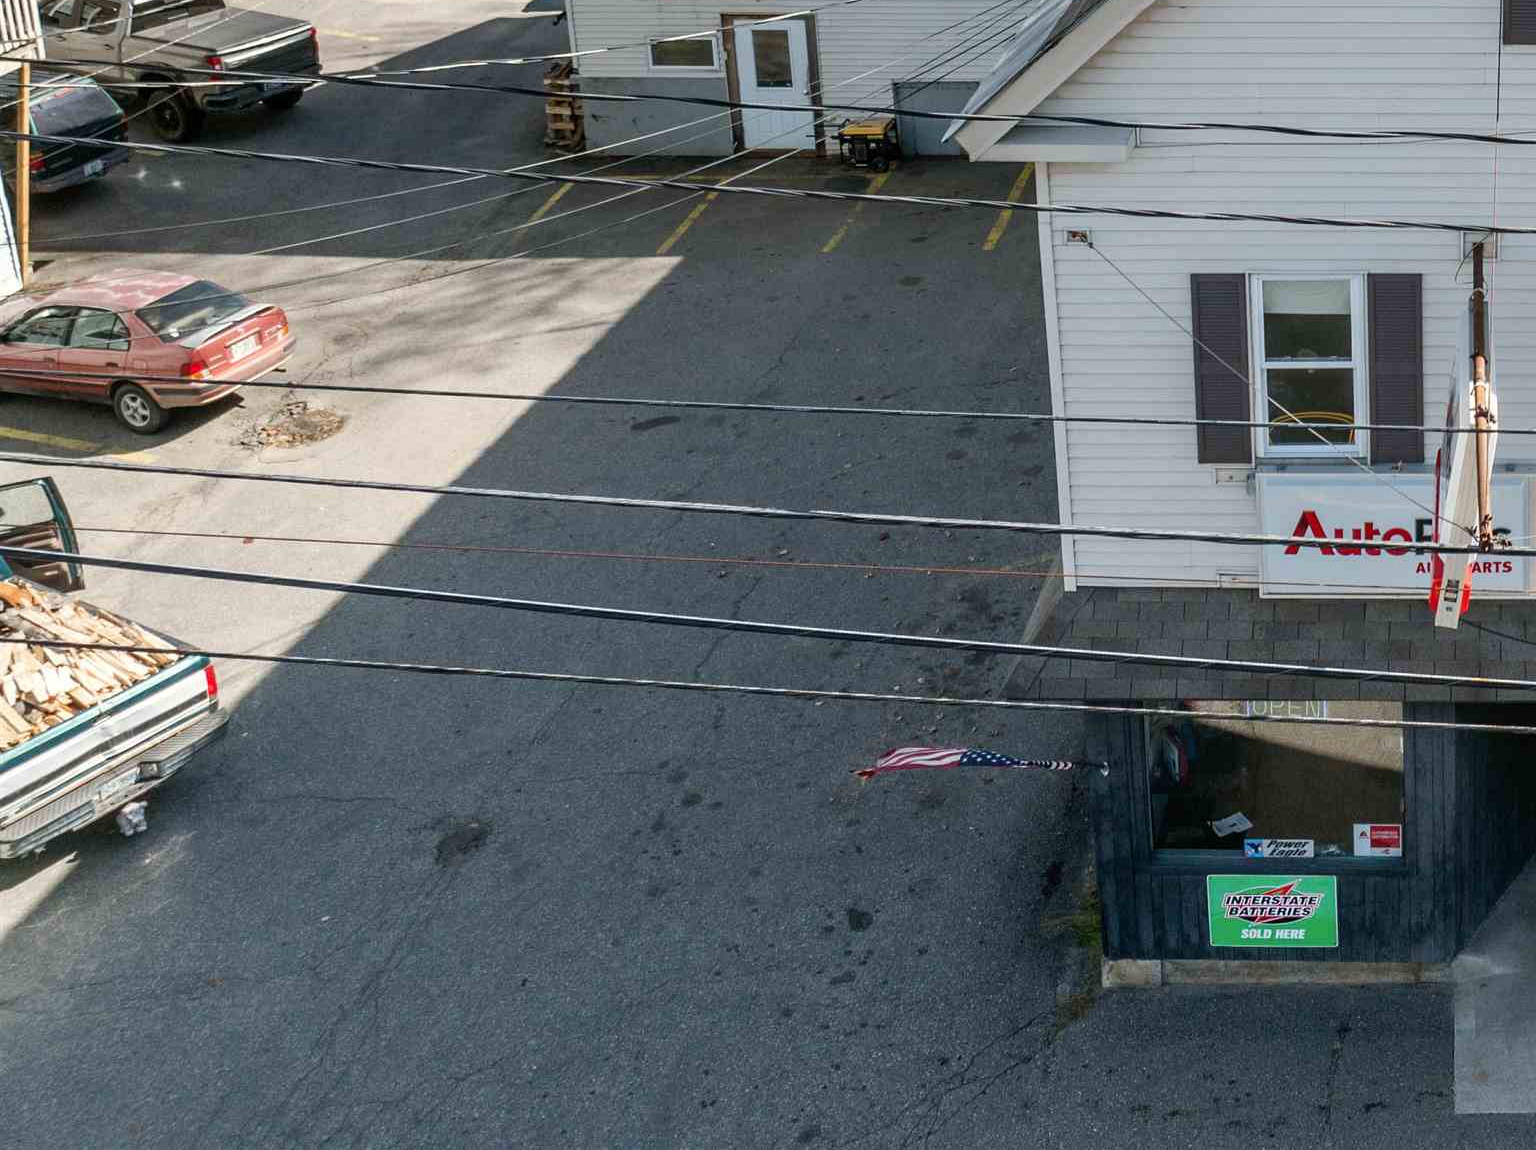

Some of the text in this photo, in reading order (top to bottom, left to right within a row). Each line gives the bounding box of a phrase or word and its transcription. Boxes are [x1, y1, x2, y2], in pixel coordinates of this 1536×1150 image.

[1471, 561, 1513, 573] ARTS
[1266, 840, 1309, 848] Power
[1226, 896, 1320, 905] INTERSTATE
[1228, 907, 1311, 916] BATTERIES
[1241, 929, 1306, 939] SOLD HERE
